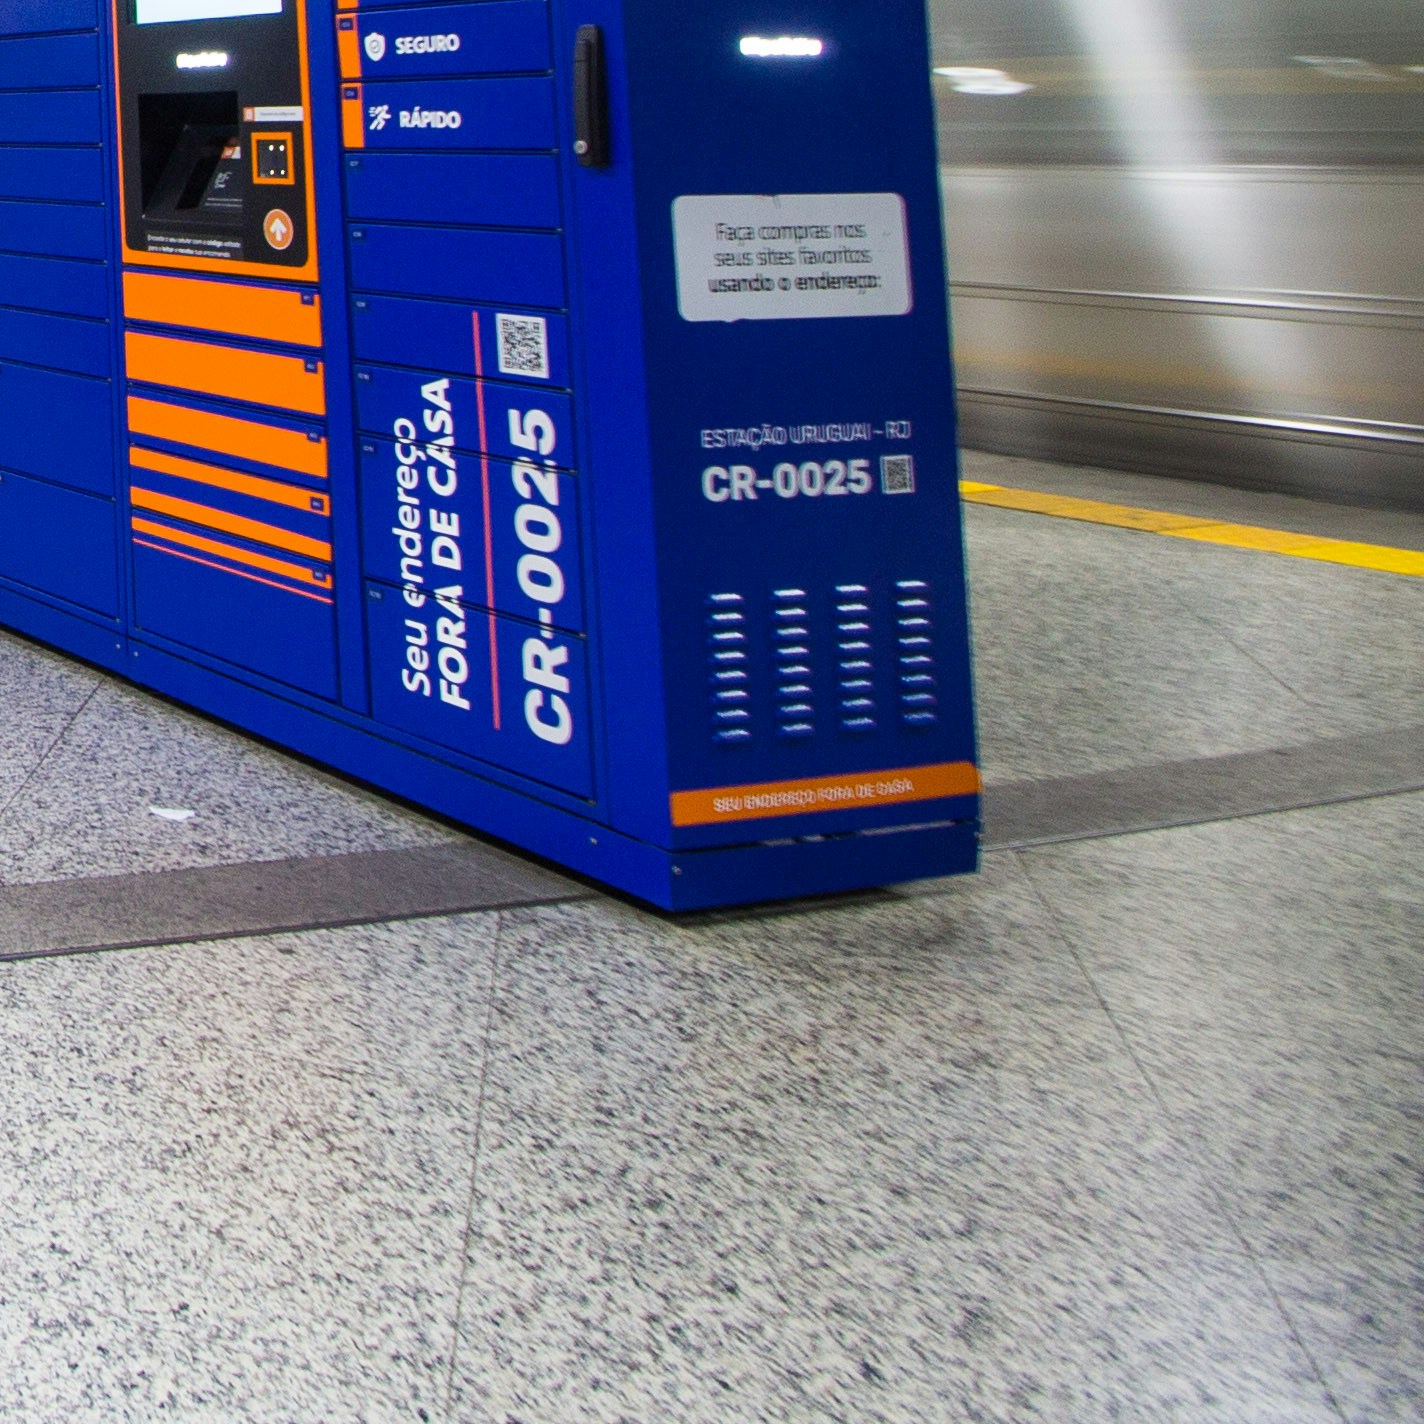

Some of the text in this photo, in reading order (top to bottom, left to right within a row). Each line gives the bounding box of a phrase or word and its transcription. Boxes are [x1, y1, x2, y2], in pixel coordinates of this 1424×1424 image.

[395, 33, 461, 54] SEGURO
[399, 106, 462, 129] RÁPIDO
[715, 222, 866, 246] Faça compras nos
[714, 245, 872, 267] seus sites favoritos
[708, 273, 775, 293] usando
[778, 276, 791, 291] o
[701, 424, 787, 451] ESTAÇÃO
[789, 422, 872, 444] URUGUAI
[885, 420, 912, 439] RJ
[702, 459, 873, 502] CR-0025
[421, 377, 472, 711] FORA DE CASA
[391, 417, 431, 697] Seu endereço
[508, 408, 574, 746] CR-0025
[713, 796, 742, 812] SEU
